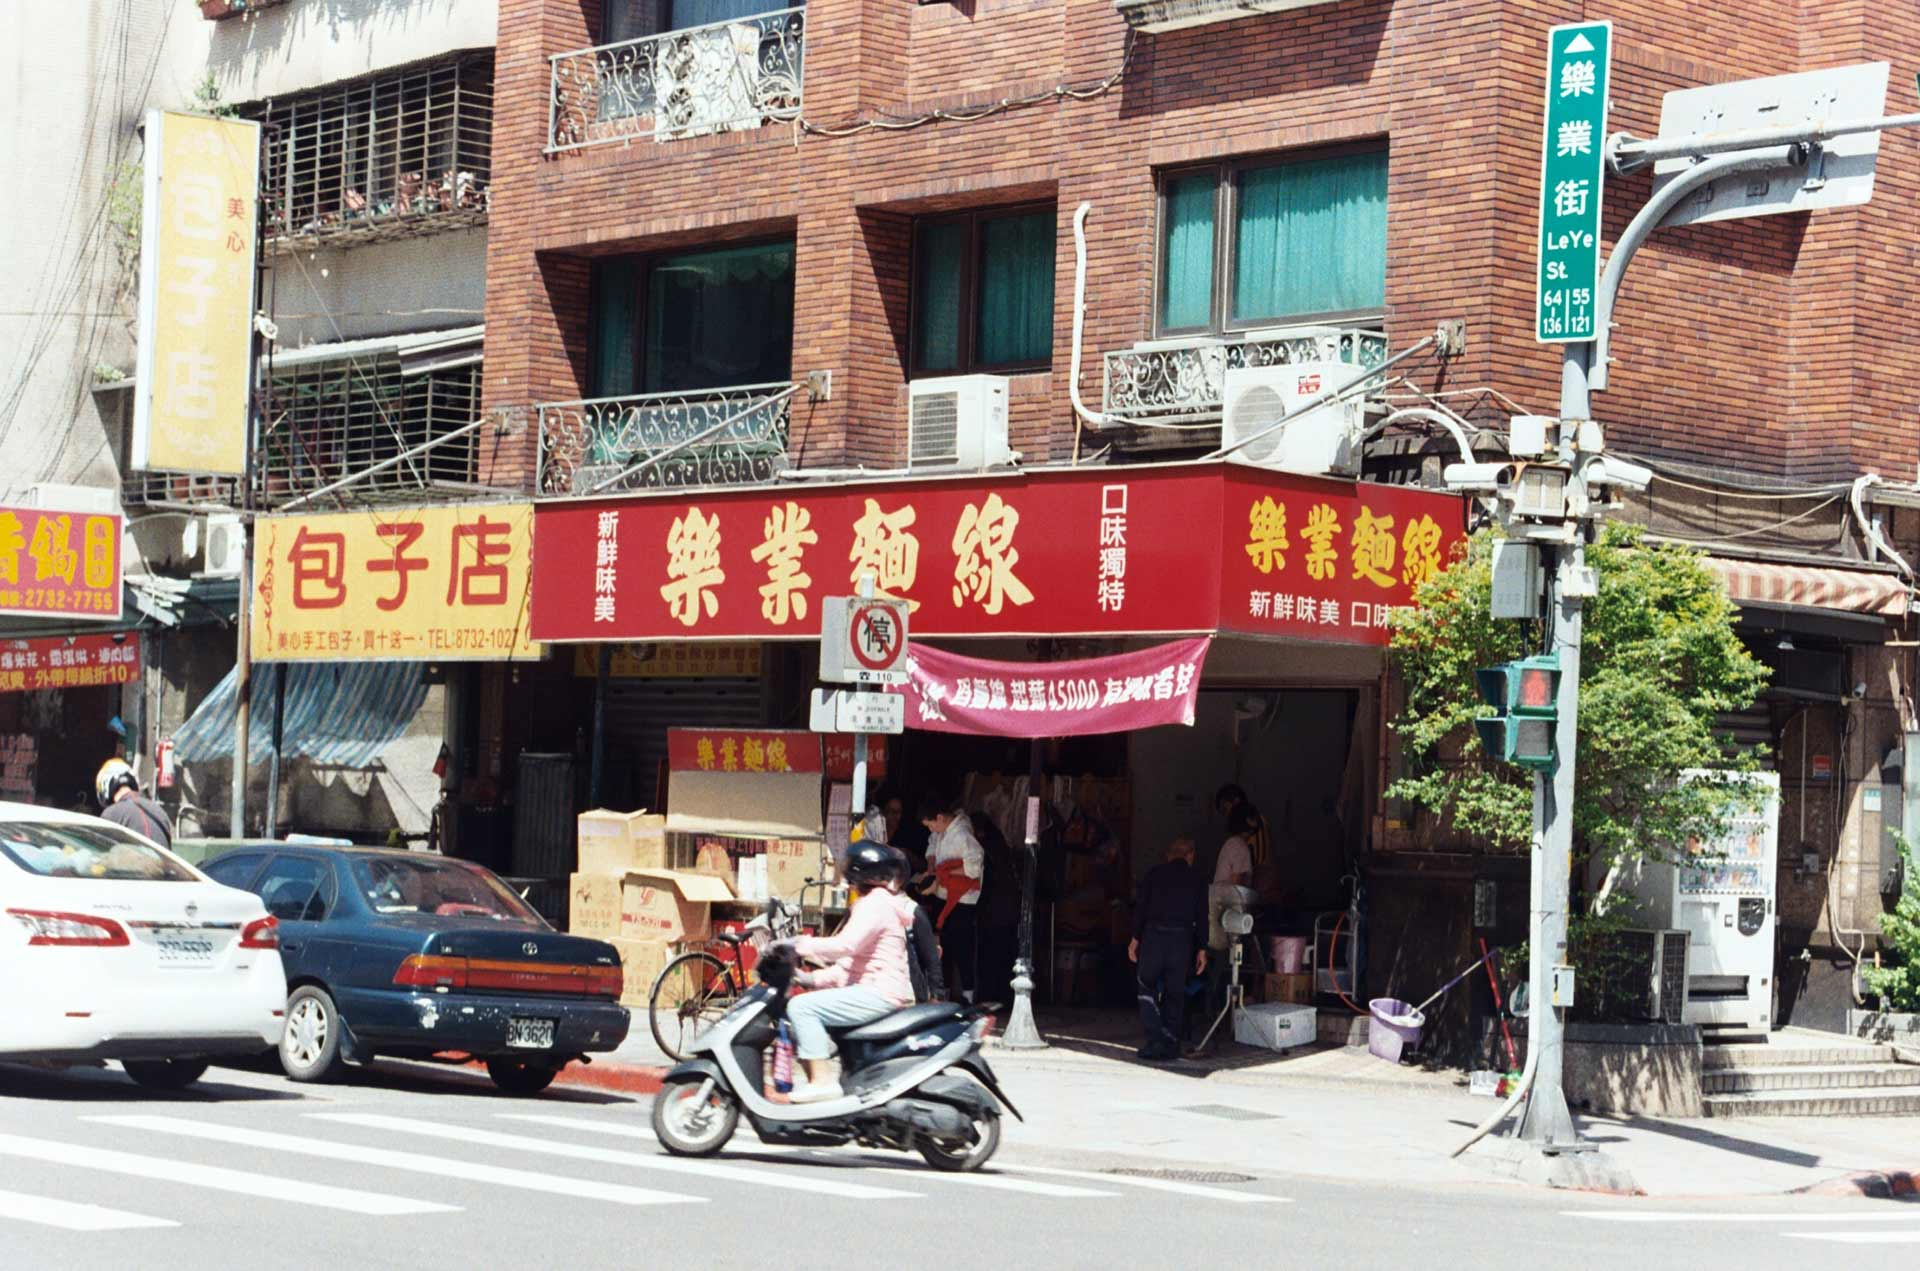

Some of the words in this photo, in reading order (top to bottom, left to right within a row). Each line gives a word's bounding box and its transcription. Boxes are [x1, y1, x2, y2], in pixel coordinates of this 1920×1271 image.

[1554, 59, 1596, 217] 樂業街
[1547, 229, 1594, 250] LeYe
[162, 174, 224, 420] 包子店
[1543, 289, 1562, 307] 64
[1572, 288, 1590, 305] 55
[1543, 317, 1562, 335] 136
[1571, 315, 1590, 333] 121
[287, 514, 512, 612] 包子店
[594, 510, 619, 623] 新鮮味美
[660, 492, 1035, 627] 樂業麵線
[1097, 484, 1128, 612] 口味獨特
[1245, 495, 1443, 589] 樂業麵線
[864, 616, 890, 653] 停
[1249, 590, 1341, 627] 新鮮味美
[696, 736, 790, 773] 樂業麵線
